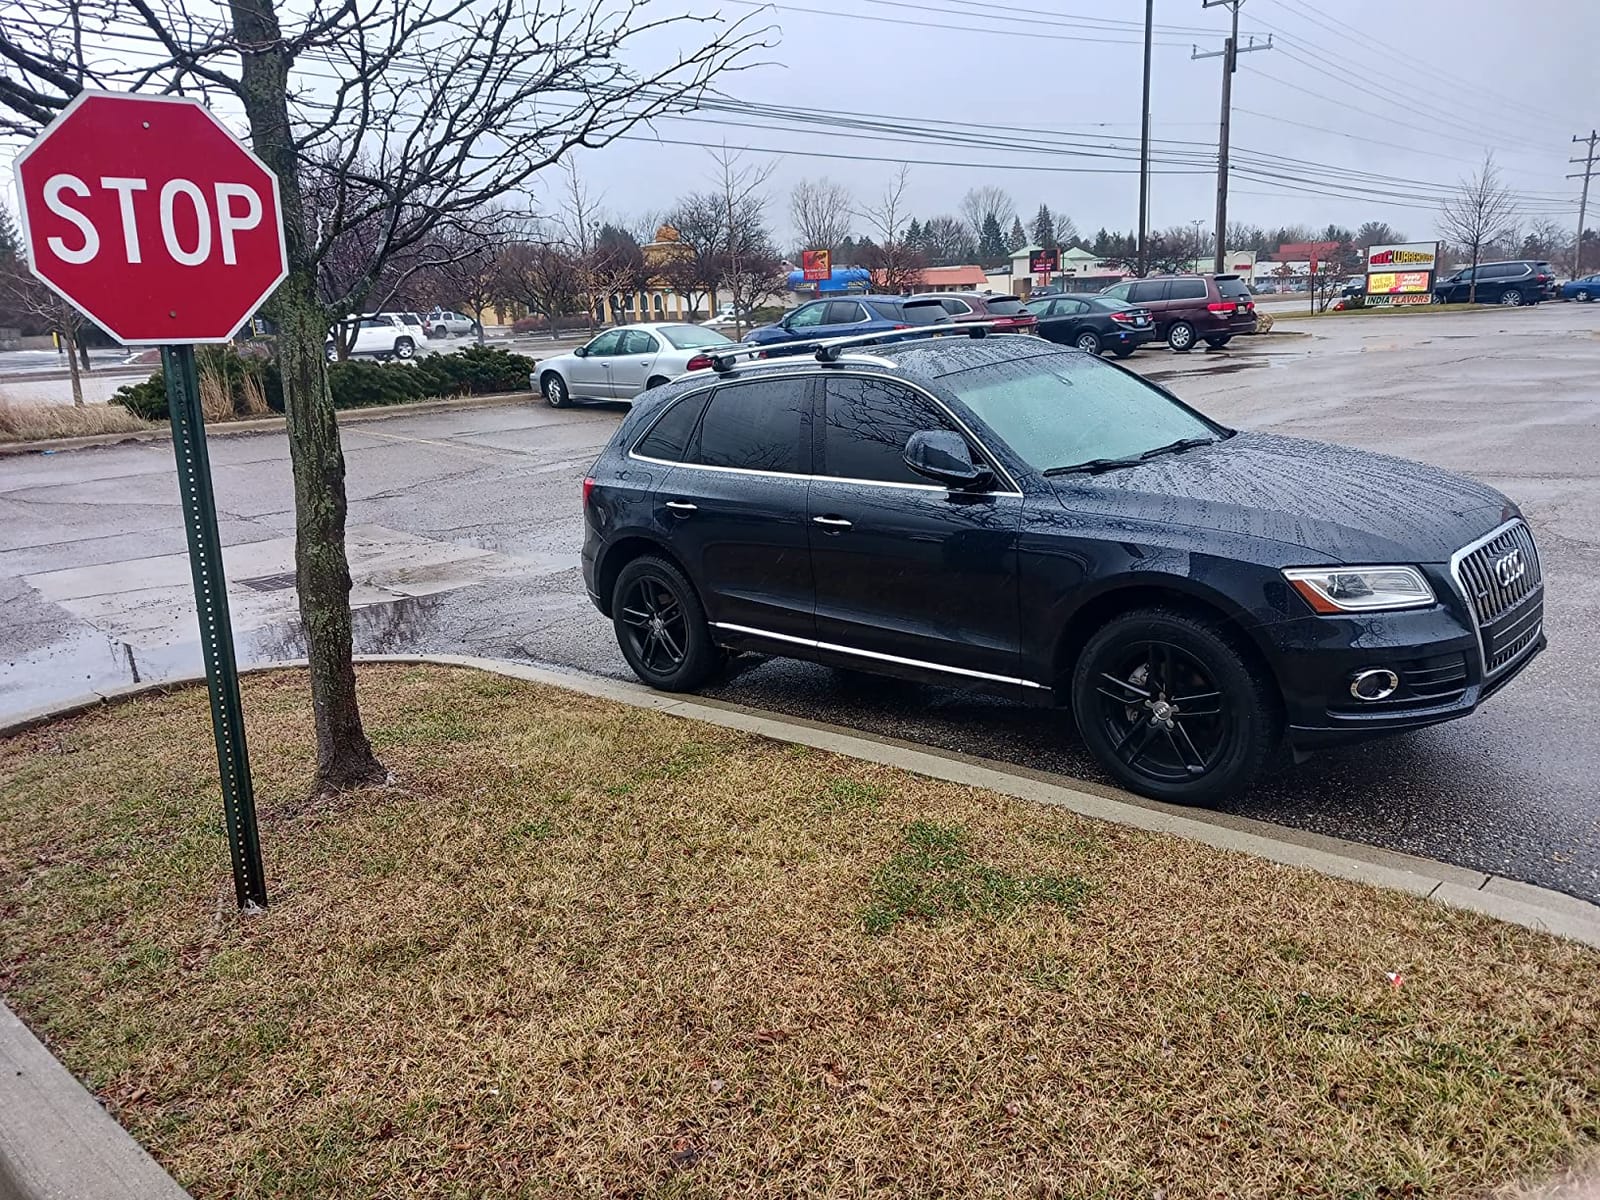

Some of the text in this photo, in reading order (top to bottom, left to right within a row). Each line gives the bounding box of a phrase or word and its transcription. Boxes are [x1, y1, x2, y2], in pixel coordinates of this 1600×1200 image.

[43, 173, 263, 266] STOP
[1367, 295, 1429, 304] INDIA FLAVORS
